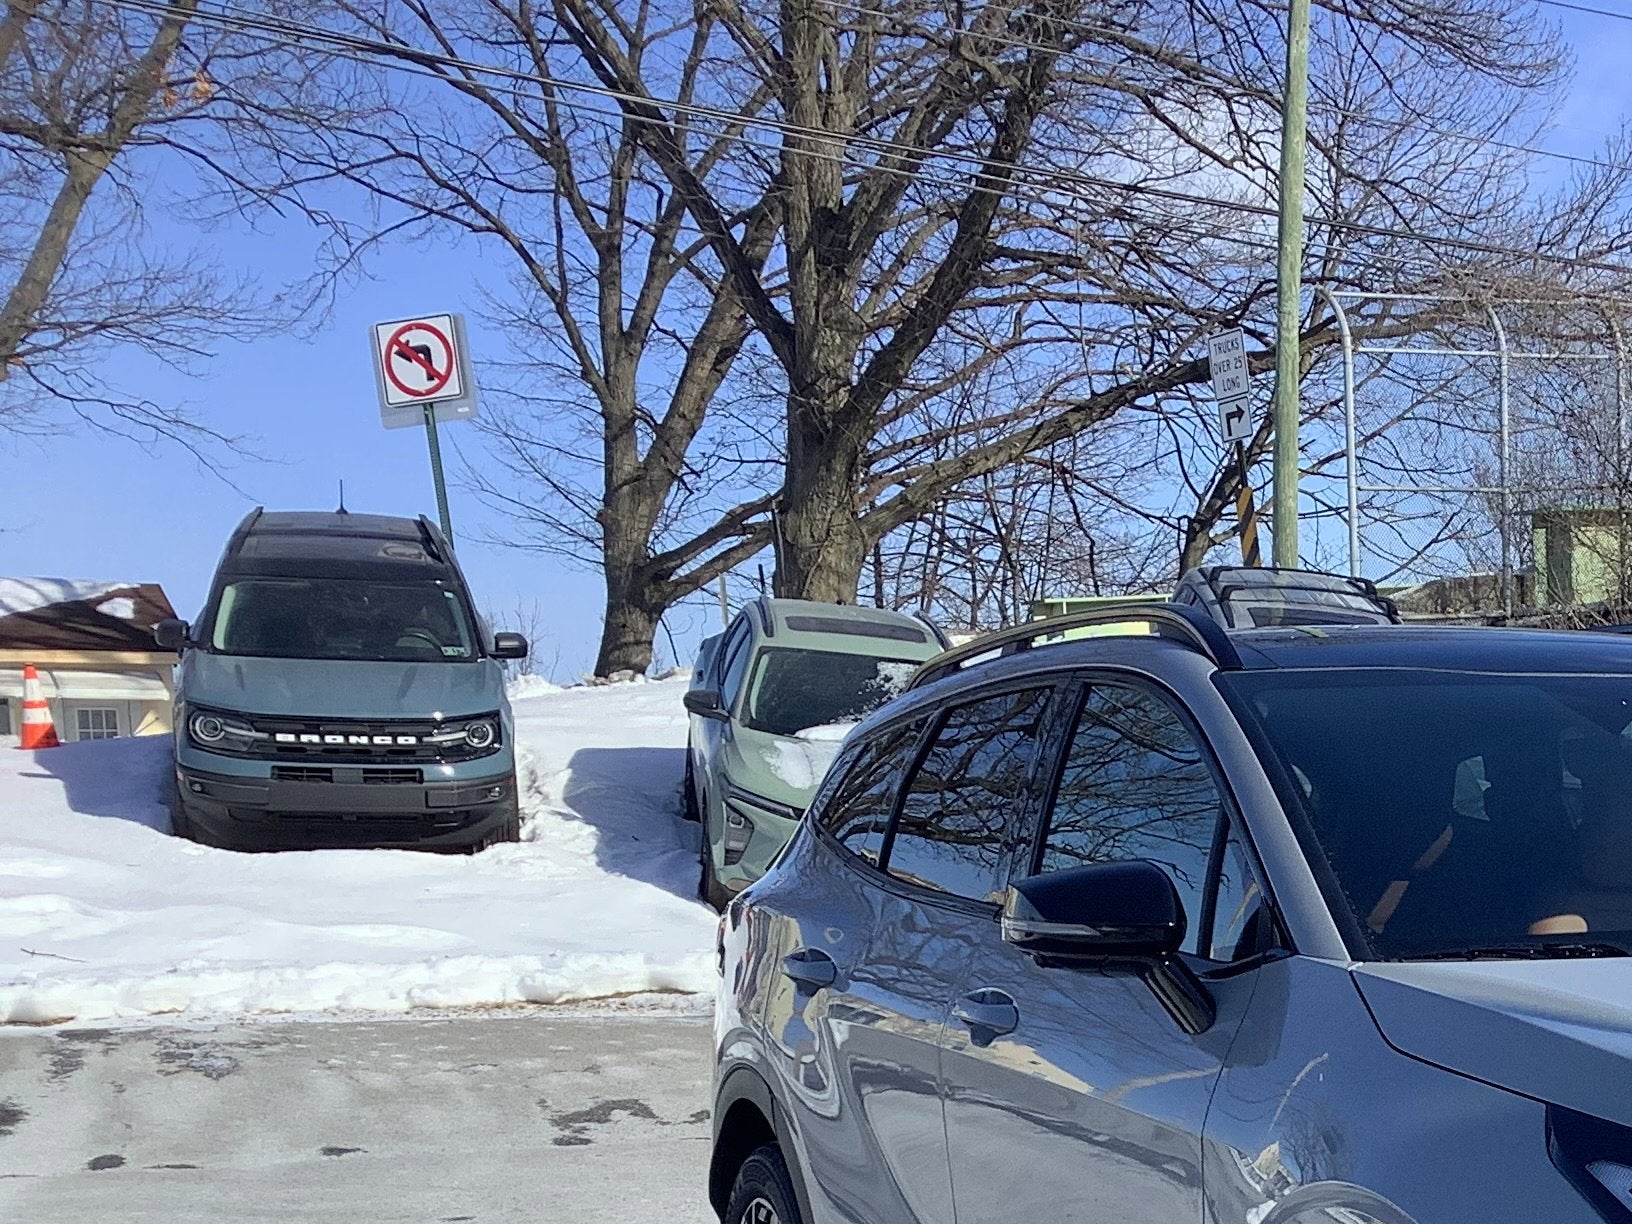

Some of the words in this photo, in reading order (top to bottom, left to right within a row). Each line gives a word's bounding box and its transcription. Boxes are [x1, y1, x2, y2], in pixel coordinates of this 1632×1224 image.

[1213, 338, 1240, 355] TRUCKS
[1214, 359, 1231, 375] OVER
[1222, 376, 1240, 391] LONG
[275, 733, 417, 745] BRONCO
